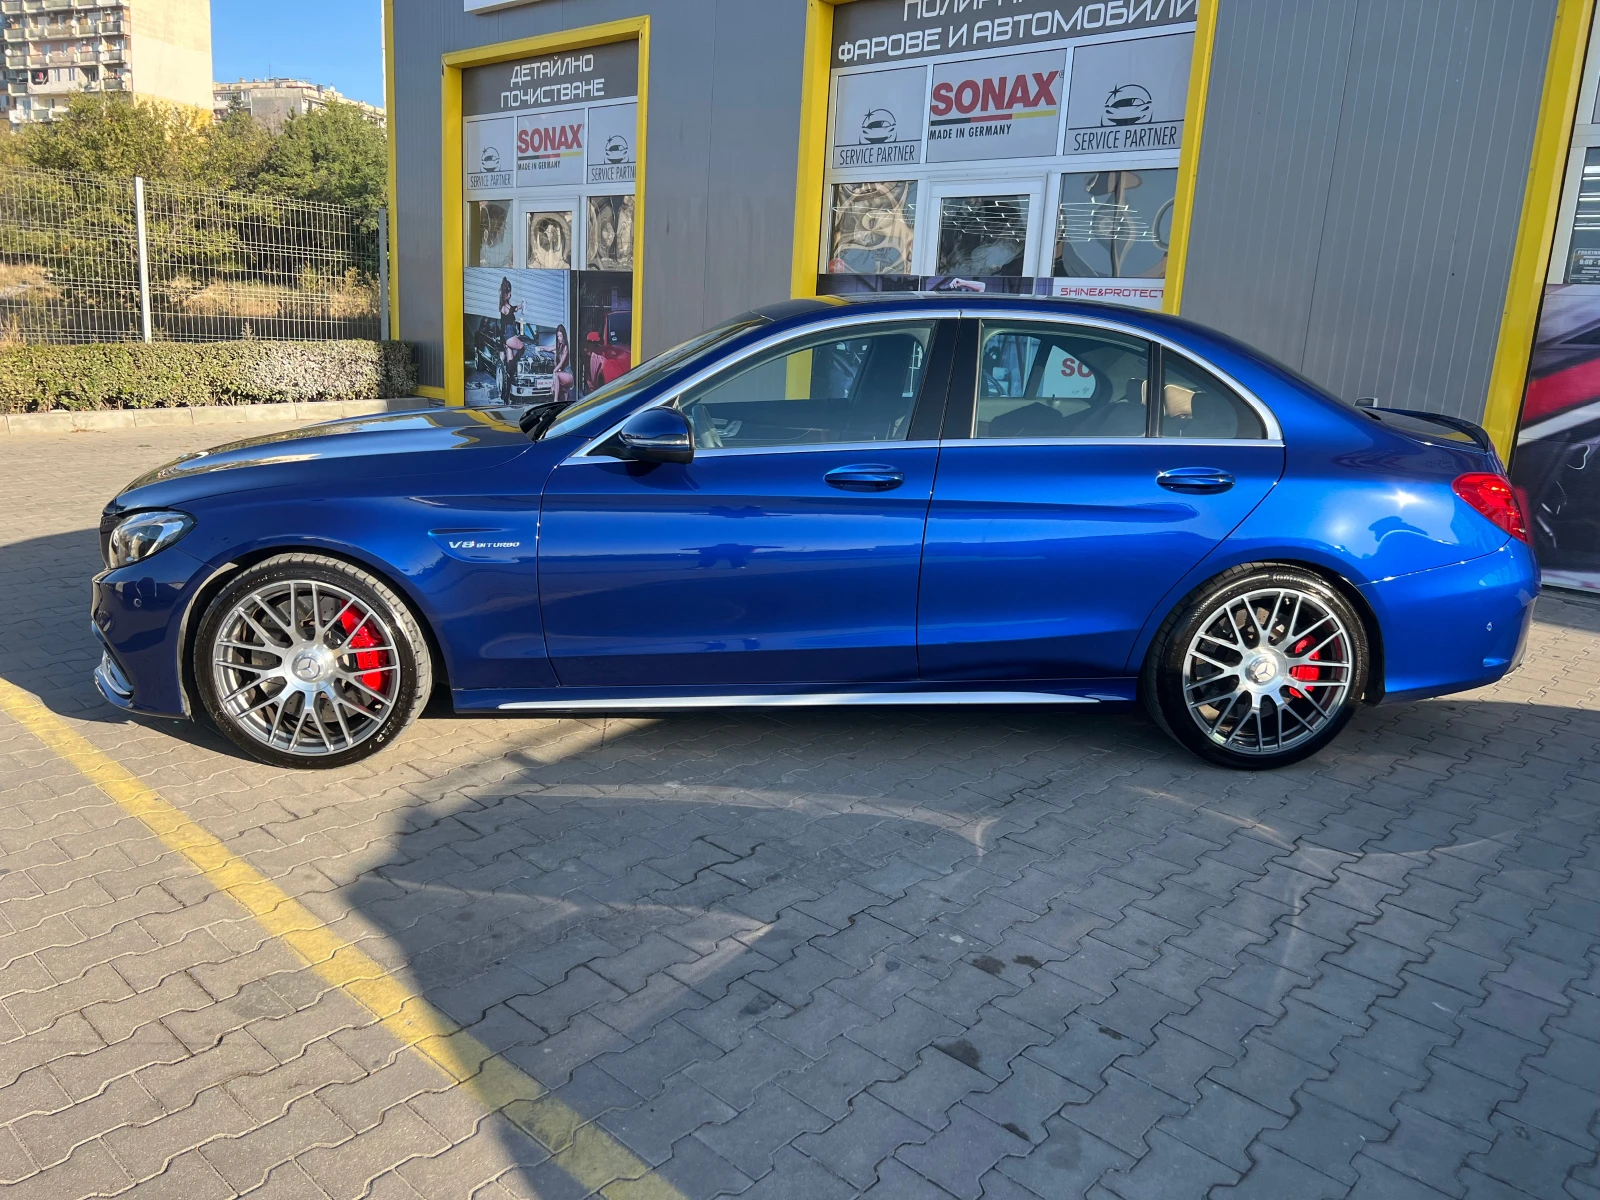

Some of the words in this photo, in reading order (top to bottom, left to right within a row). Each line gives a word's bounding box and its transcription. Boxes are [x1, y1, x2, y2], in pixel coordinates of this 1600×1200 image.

[838, 27, 942, 62] ФАРОВЕ
[948, 23, 968, 48] И
[973, 0, 1199, 45] АВТОМОБИЛИ
[511, 54, 594, 87] ДЕТАЙЛНО
[500, 78, 605, 108] ПОЧИСТВАНЕ
[931, 70, 1059, 116] SONAX
[517, 123, 583, 154] SONAX
[929, 128, 953, 141] MADE
[956, 127, 965, 138] IN
[968, 124, 1011, 137] GERMANY
[1074, 130, 1121, 151] SERVICE
[1124, 126, 1177, 148] PARTNER
[532, 161, 537, 170] IN
[538, 160, 561, 170] GERMANY
[839, 147, 874, 165] SERVICE
[876, 145, 915, 163] PARTNER
[470, 175, 489, 188] SERVICE
[490, 174, 512, 187] PARTNER
[591, 166, 614, 181] SERVICE
[615, 164, 636, 180] PARTN
[449, 540, 475, 549] V8
